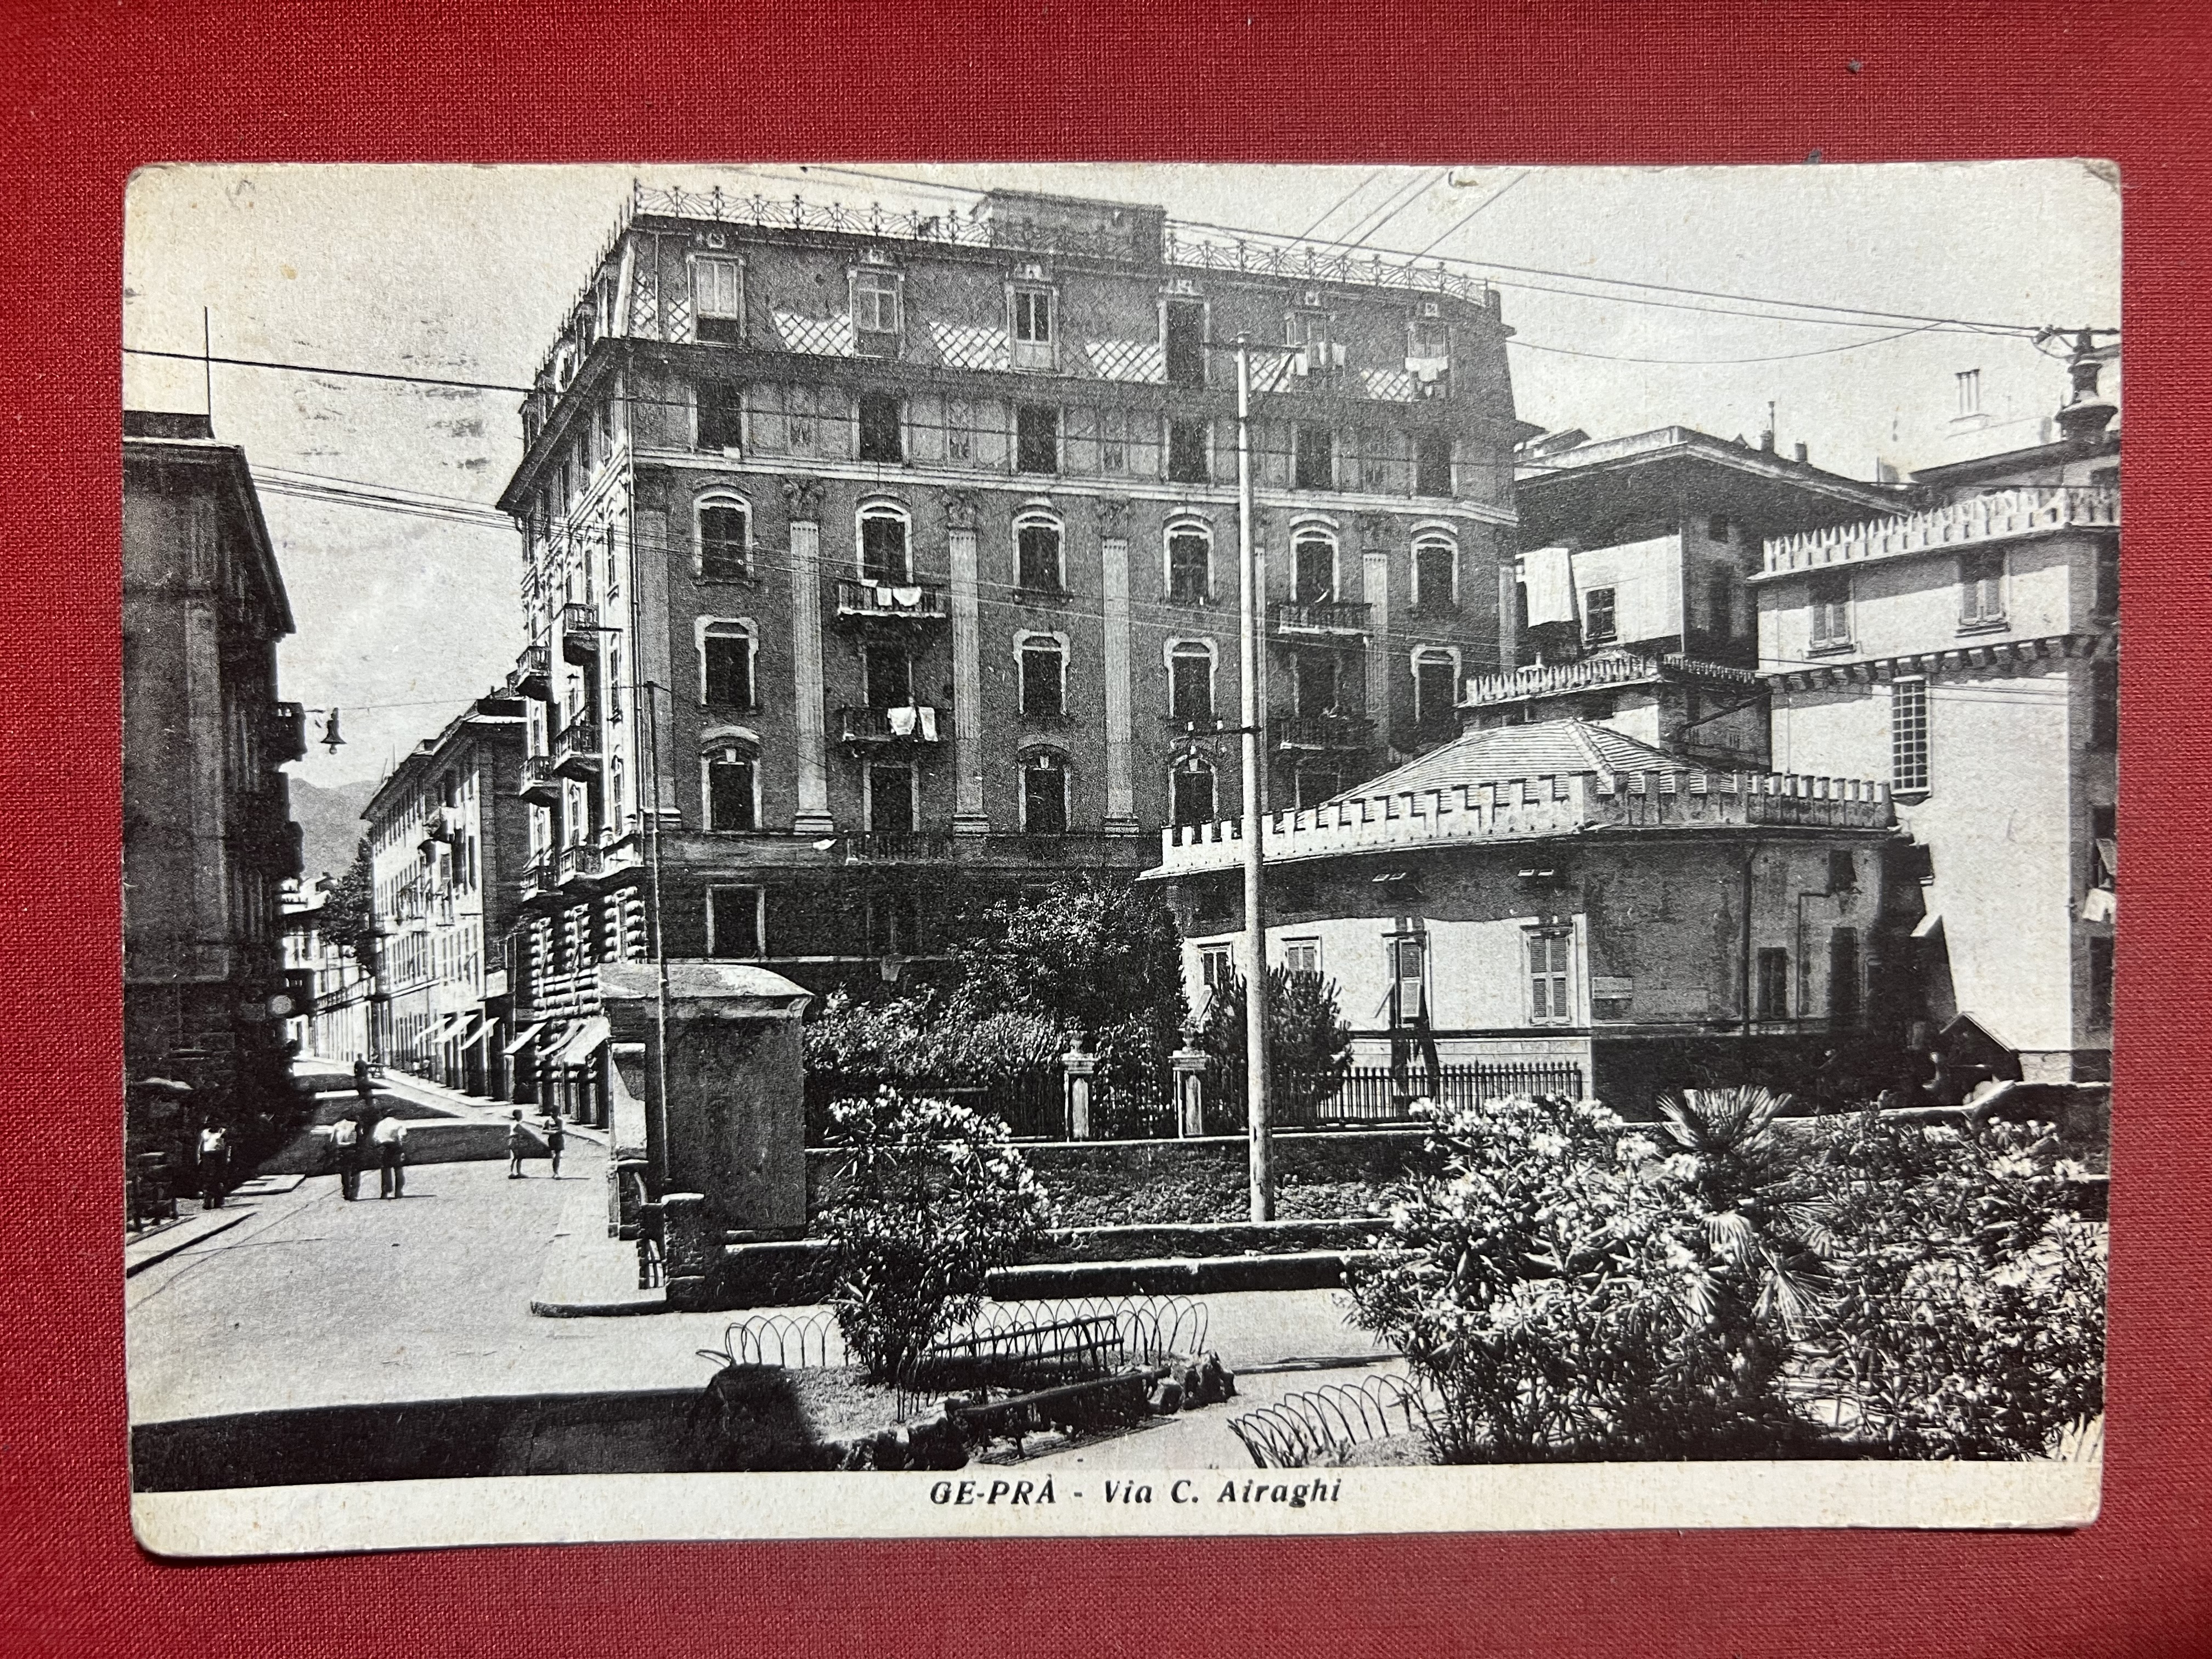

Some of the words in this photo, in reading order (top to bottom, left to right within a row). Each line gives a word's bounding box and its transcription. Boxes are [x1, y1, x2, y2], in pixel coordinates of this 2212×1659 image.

[929, 1474, 1056, 1505] GE-PRÀ
[1105, 1480, 1153, 1505] Via
[1170, 1480, 1199, 1504] C.
[1216, 1478, 1342, 1509] Airaghi
